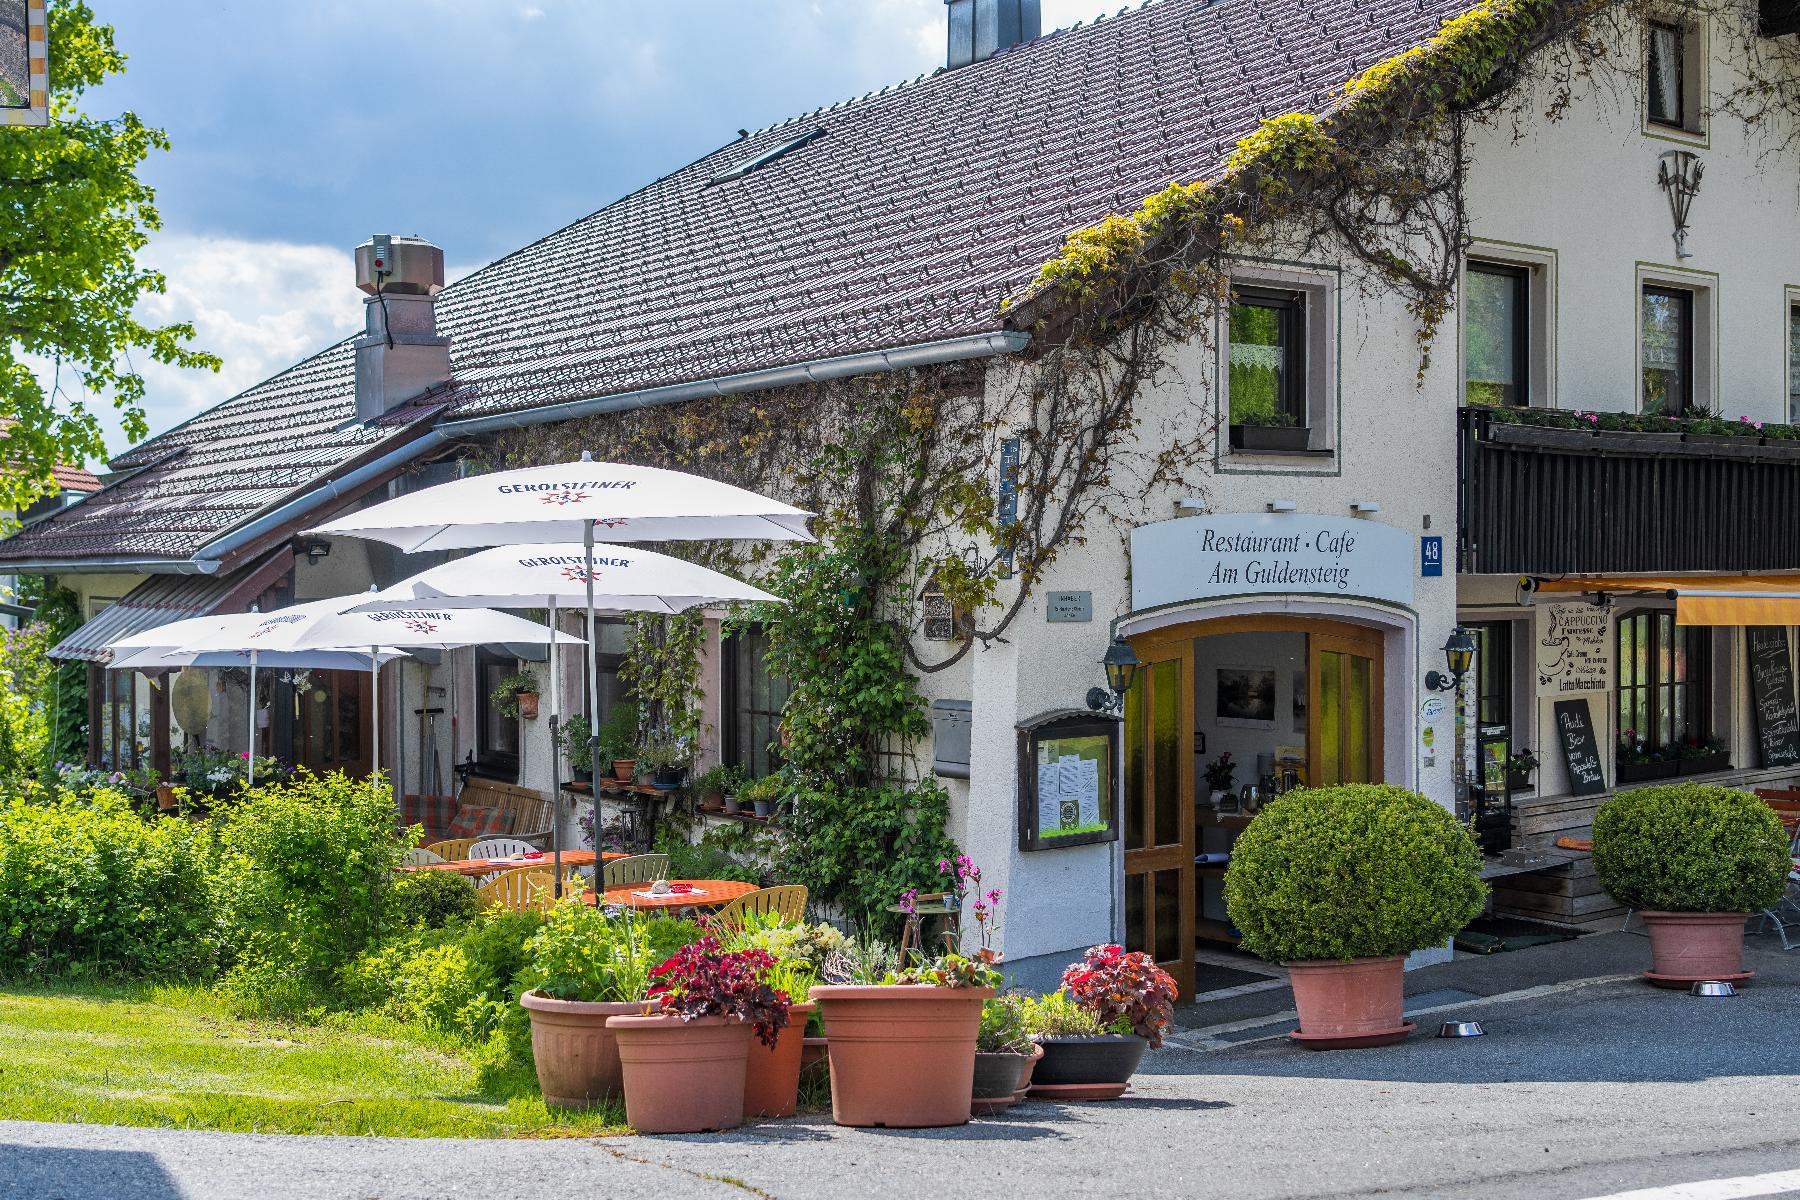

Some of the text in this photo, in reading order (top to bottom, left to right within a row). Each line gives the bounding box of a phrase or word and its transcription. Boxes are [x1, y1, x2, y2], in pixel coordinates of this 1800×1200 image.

[498, 480, 637, 494] GEROLSTEINER
[1201, 528, 1356, 559] Restaurant Cafe
[1425, 541, 1438, 560] 48
[1207, 560, 1350, 590] Am Guldensteig
[367, 611, 452, 622] GEROLSTEINER
[1558, 614, 1608, 627] CAPPUCCINO
